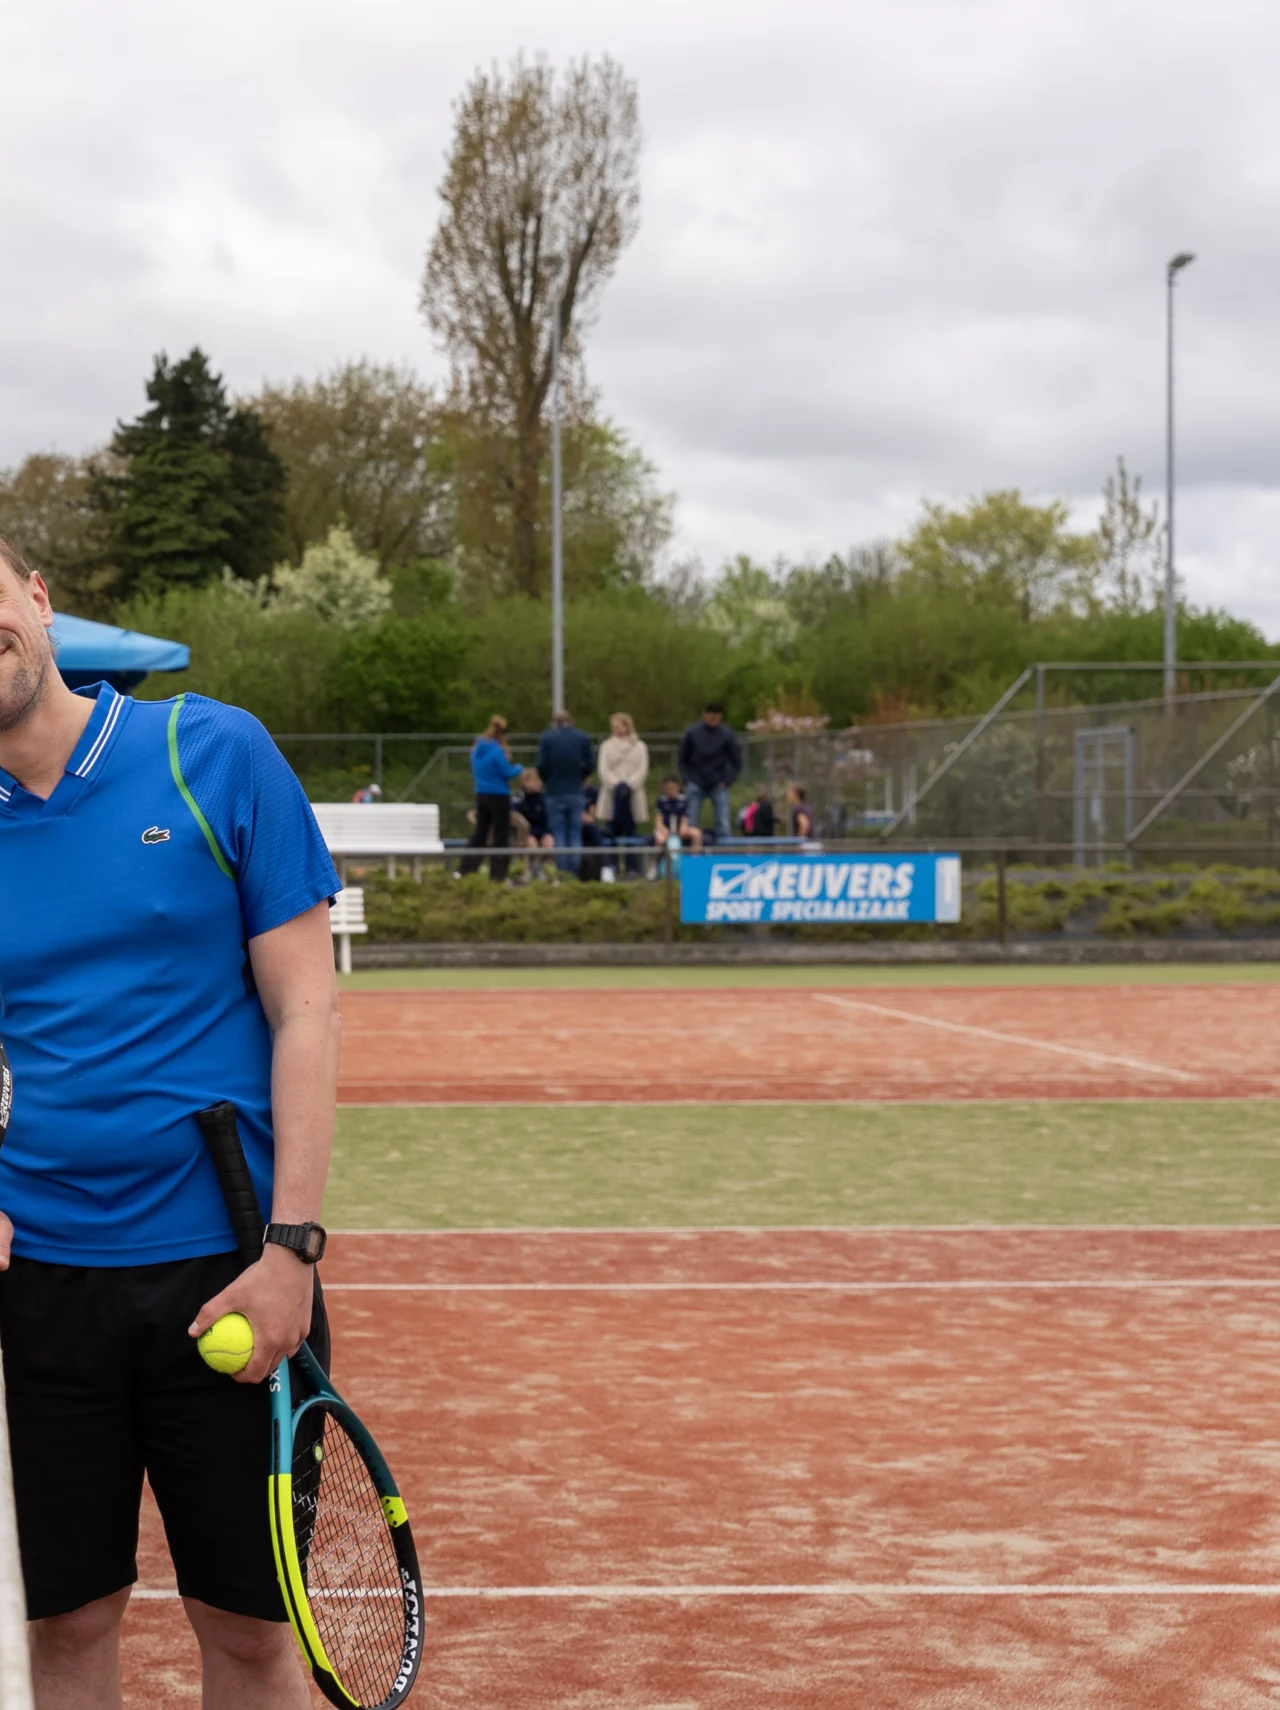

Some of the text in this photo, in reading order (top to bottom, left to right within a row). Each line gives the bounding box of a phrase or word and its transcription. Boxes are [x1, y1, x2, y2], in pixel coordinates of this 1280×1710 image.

[749, 861, 915, 899] REUVERS
[705, 899, 911, 921] SPORT SPECIAALZAAK
